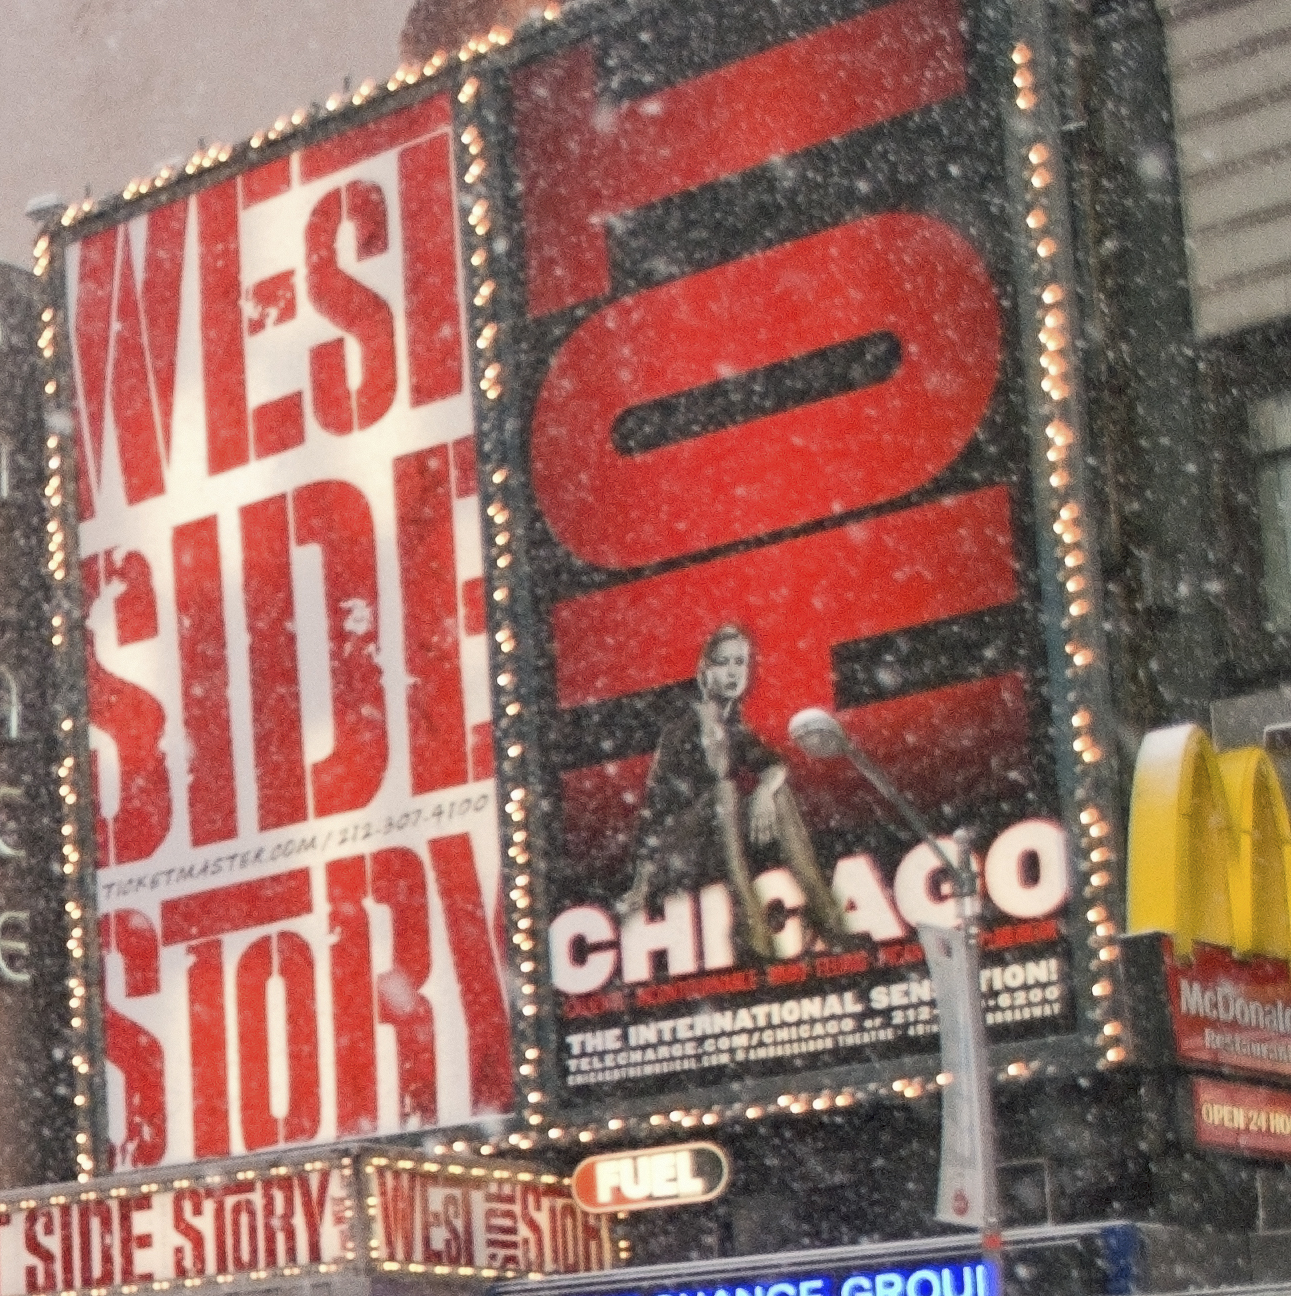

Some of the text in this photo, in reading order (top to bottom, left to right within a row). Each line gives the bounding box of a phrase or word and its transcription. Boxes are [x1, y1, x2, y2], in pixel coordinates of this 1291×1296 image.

[69, 88, 467, 530] WEST
[81, 435, 495, 868] SIDE
[102, 836, 320, 900] TICKETMASTER.COM
[548, 815, 1070, 995] CHICAGO
[101, 832, 514, 1168] STORY
[565, 1027, 622, 1057] THE
[627, 990, 863, 1048] INTERNATIONAL
[868, 957, 1060, 1011] SENTION!
[567, 1016, 857, 1074] TELECHARGE.COM/CHICAGO
[890, 983, 1061, 1026] 212--6200
[1202, 1101, 1246, 1130] OPEN
[1248, 1107, 1268, 1133] 24
[374, 1167, 475, 1266] WEST
[595, 1151, 702, 1204] FUEL
[23, 1194, 155, 1295] SIDE
[172, 1168, 334, 1278] STORY
